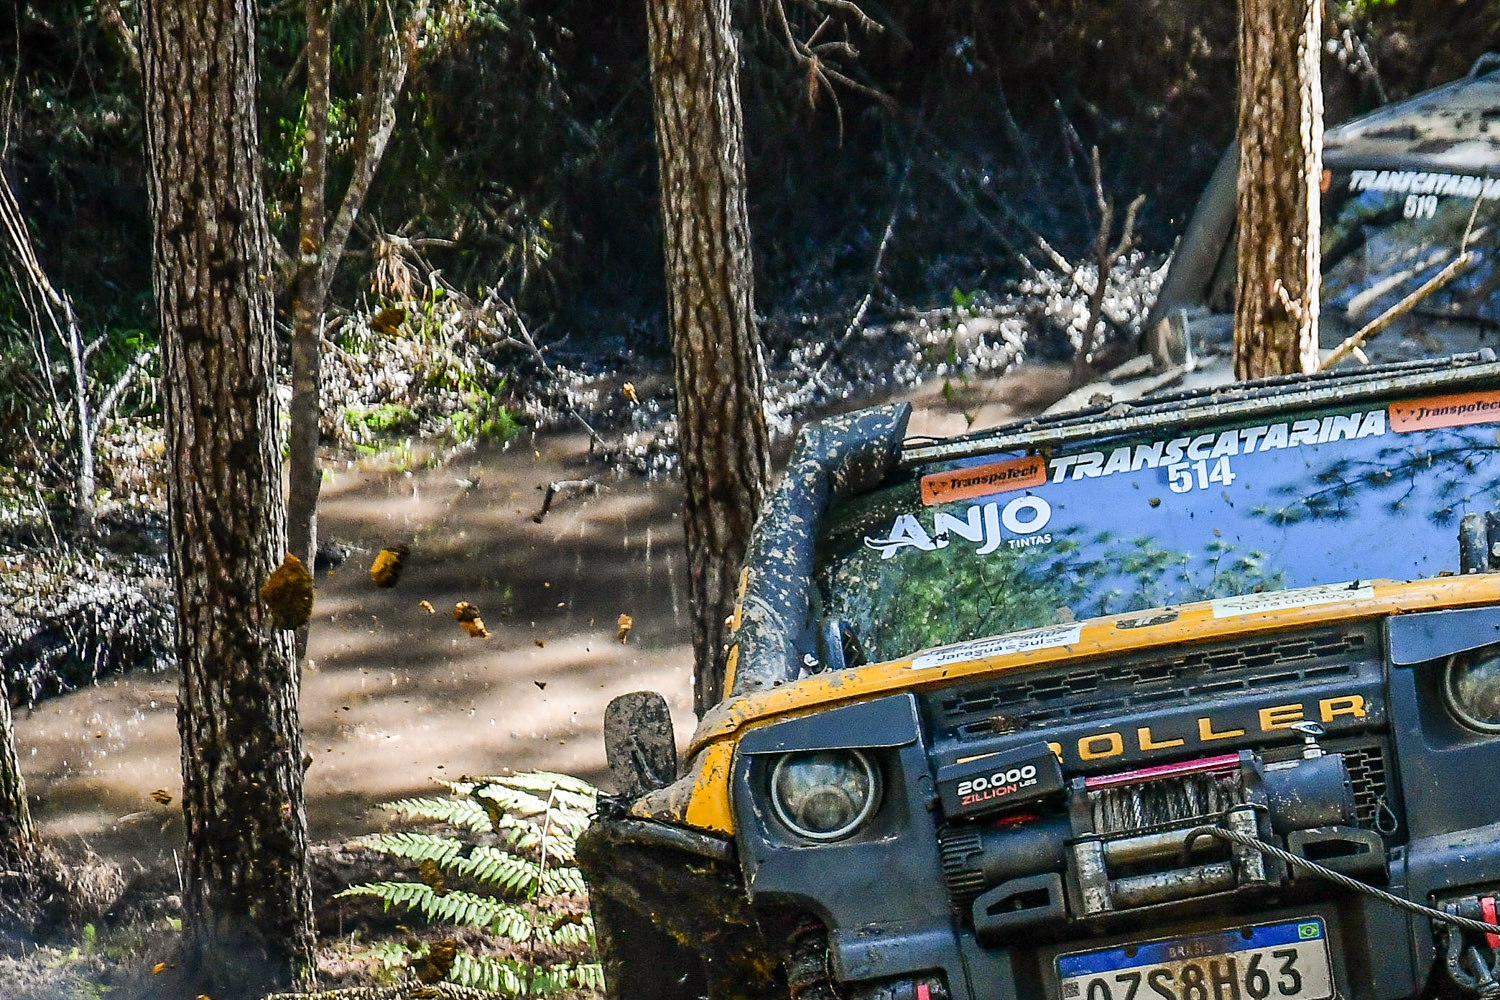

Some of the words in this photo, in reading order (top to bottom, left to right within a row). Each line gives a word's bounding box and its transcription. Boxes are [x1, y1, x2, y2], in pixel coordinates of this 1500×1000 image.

[1050, 409, 1386, 484] TRANSCATARINA
[949, 464, 1038, 490] TranspoTech
[1168, 456, 1236, 494] 514
[864, 495, 1051, 560] ANJO
[1008, 533, 1052, 550] TINTAS
[957, 694, 1367, 765] OLLER
[957, 765, 1037, 796] 20.000
[962, 784, 1018, 805] ZILLION
